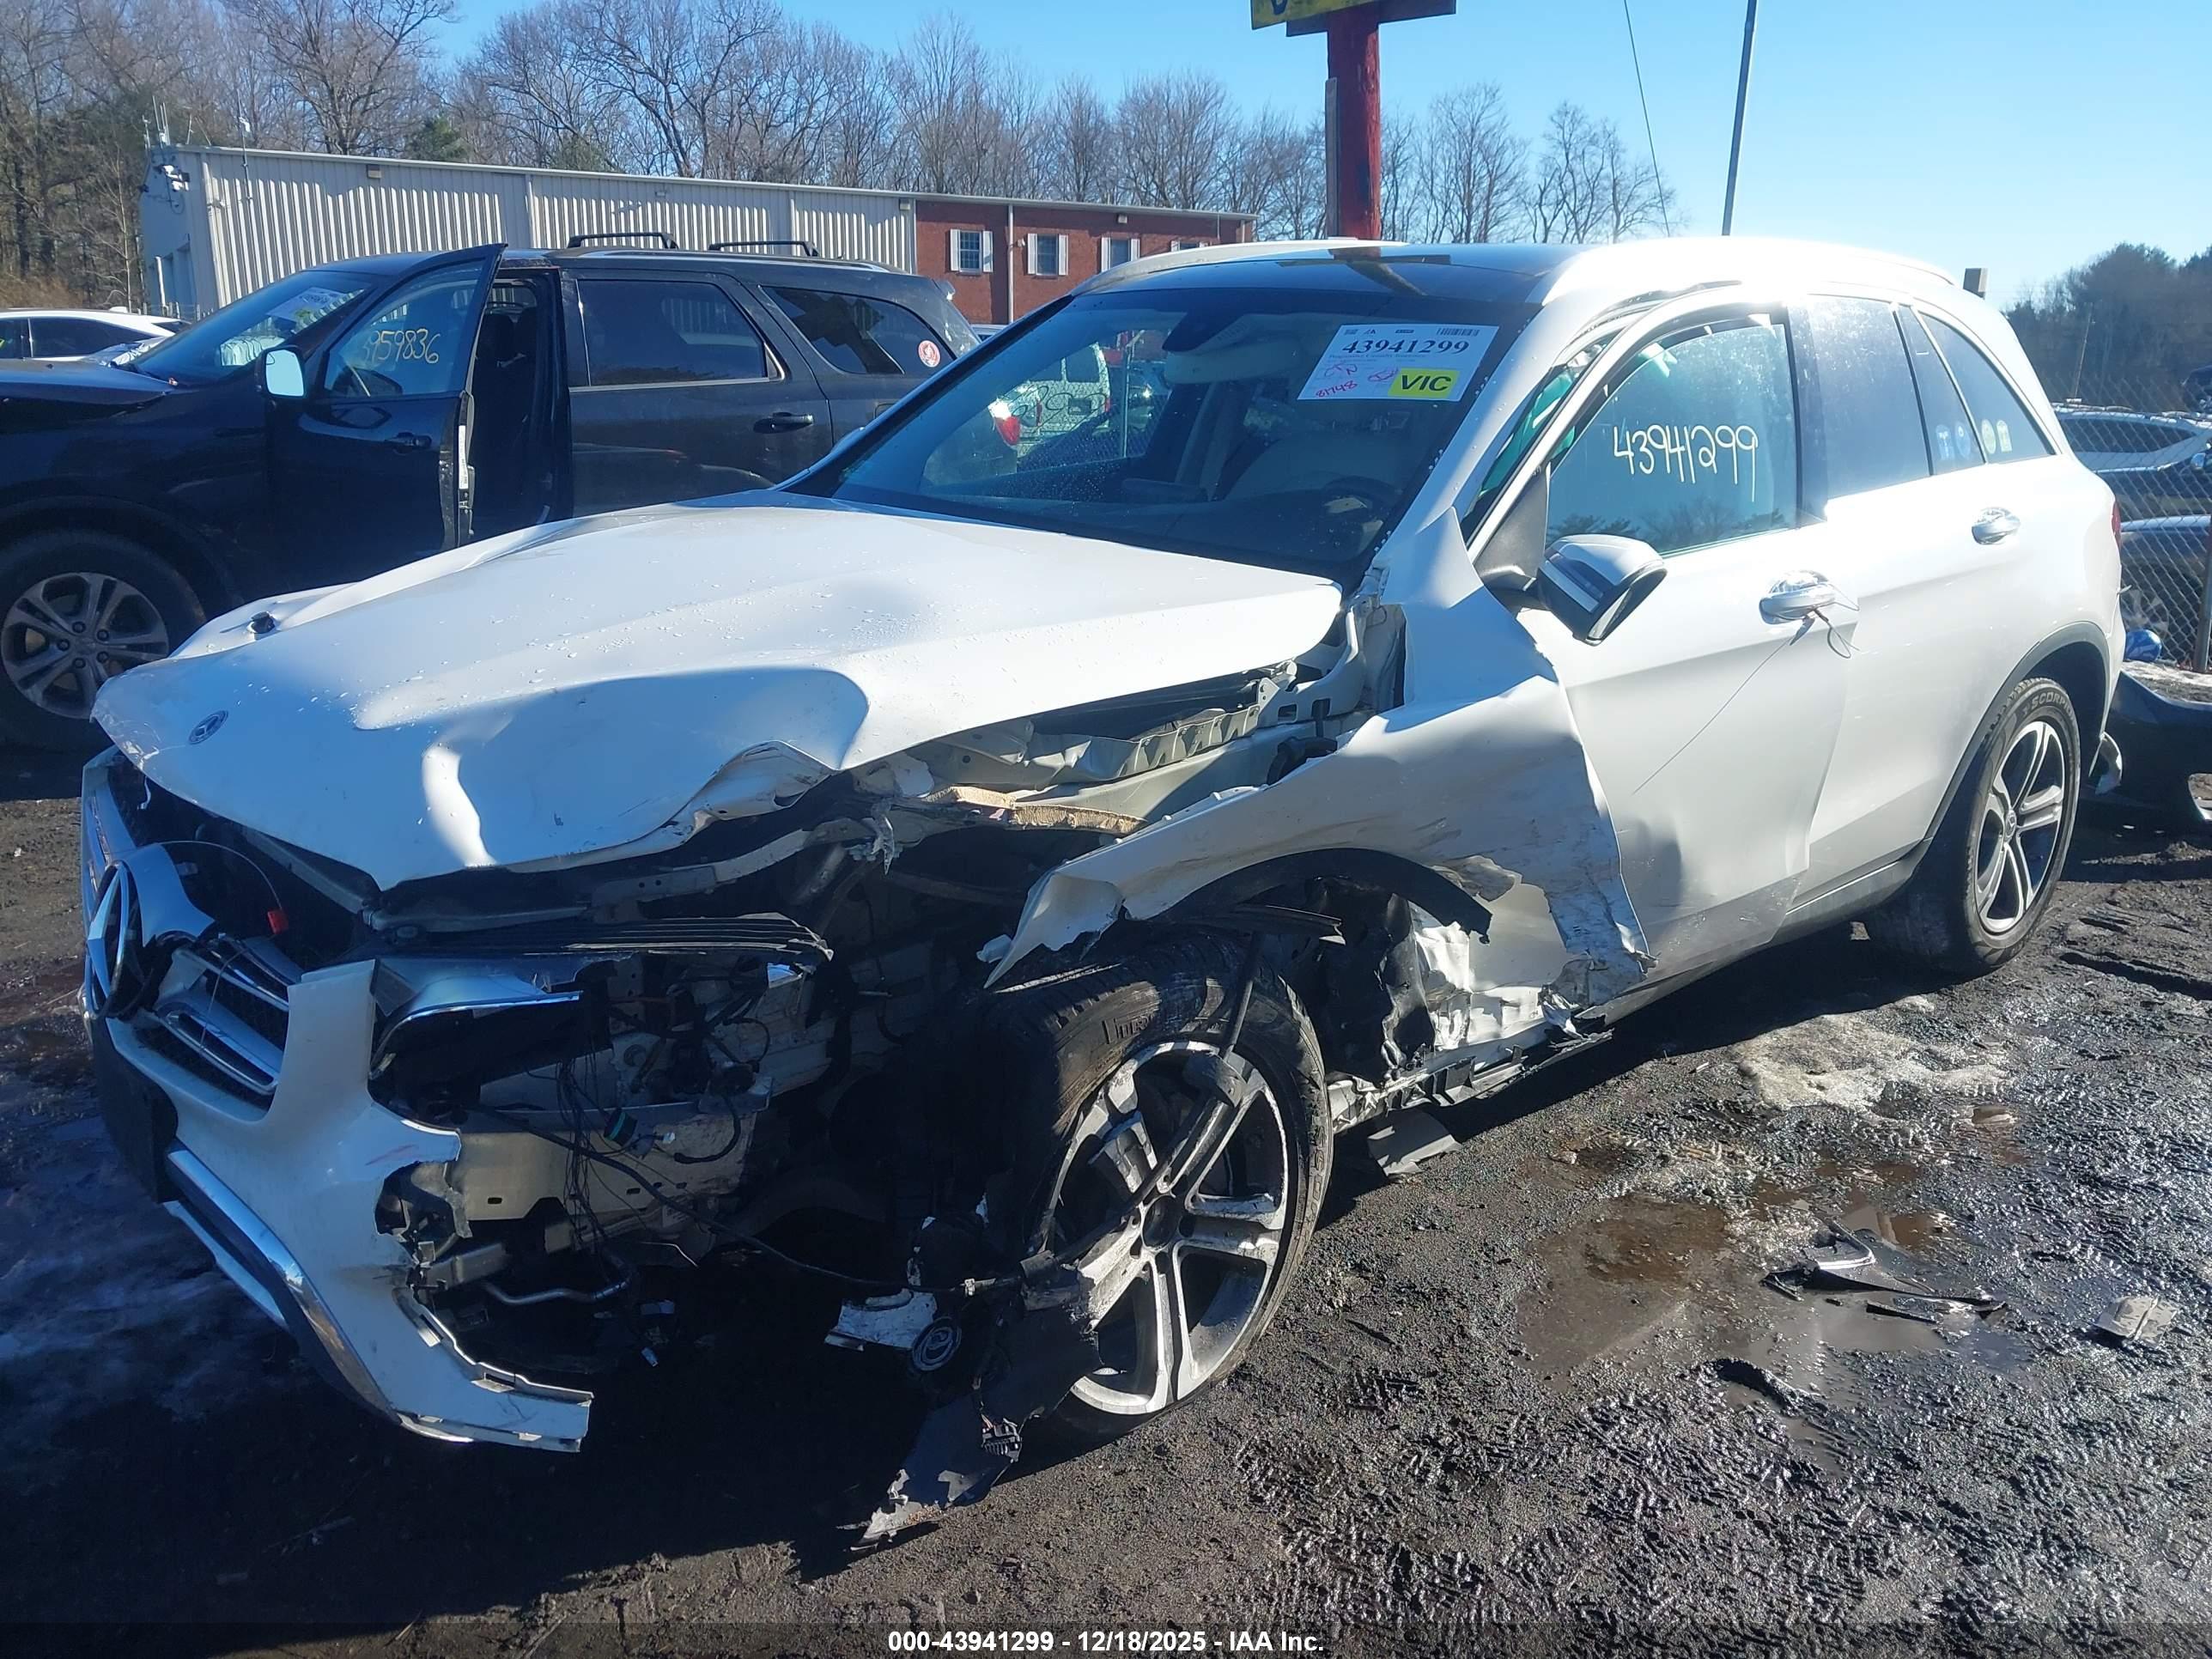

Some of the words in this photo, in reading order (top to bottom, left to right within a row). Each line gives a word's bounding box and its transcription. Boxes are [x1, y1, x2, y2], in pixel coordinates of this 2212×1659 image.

[1342, 339, 1470, 355] 43941299
[1401, 374, 1451, 391] VIC
[1613, 424, 1759, 502] 43941299
